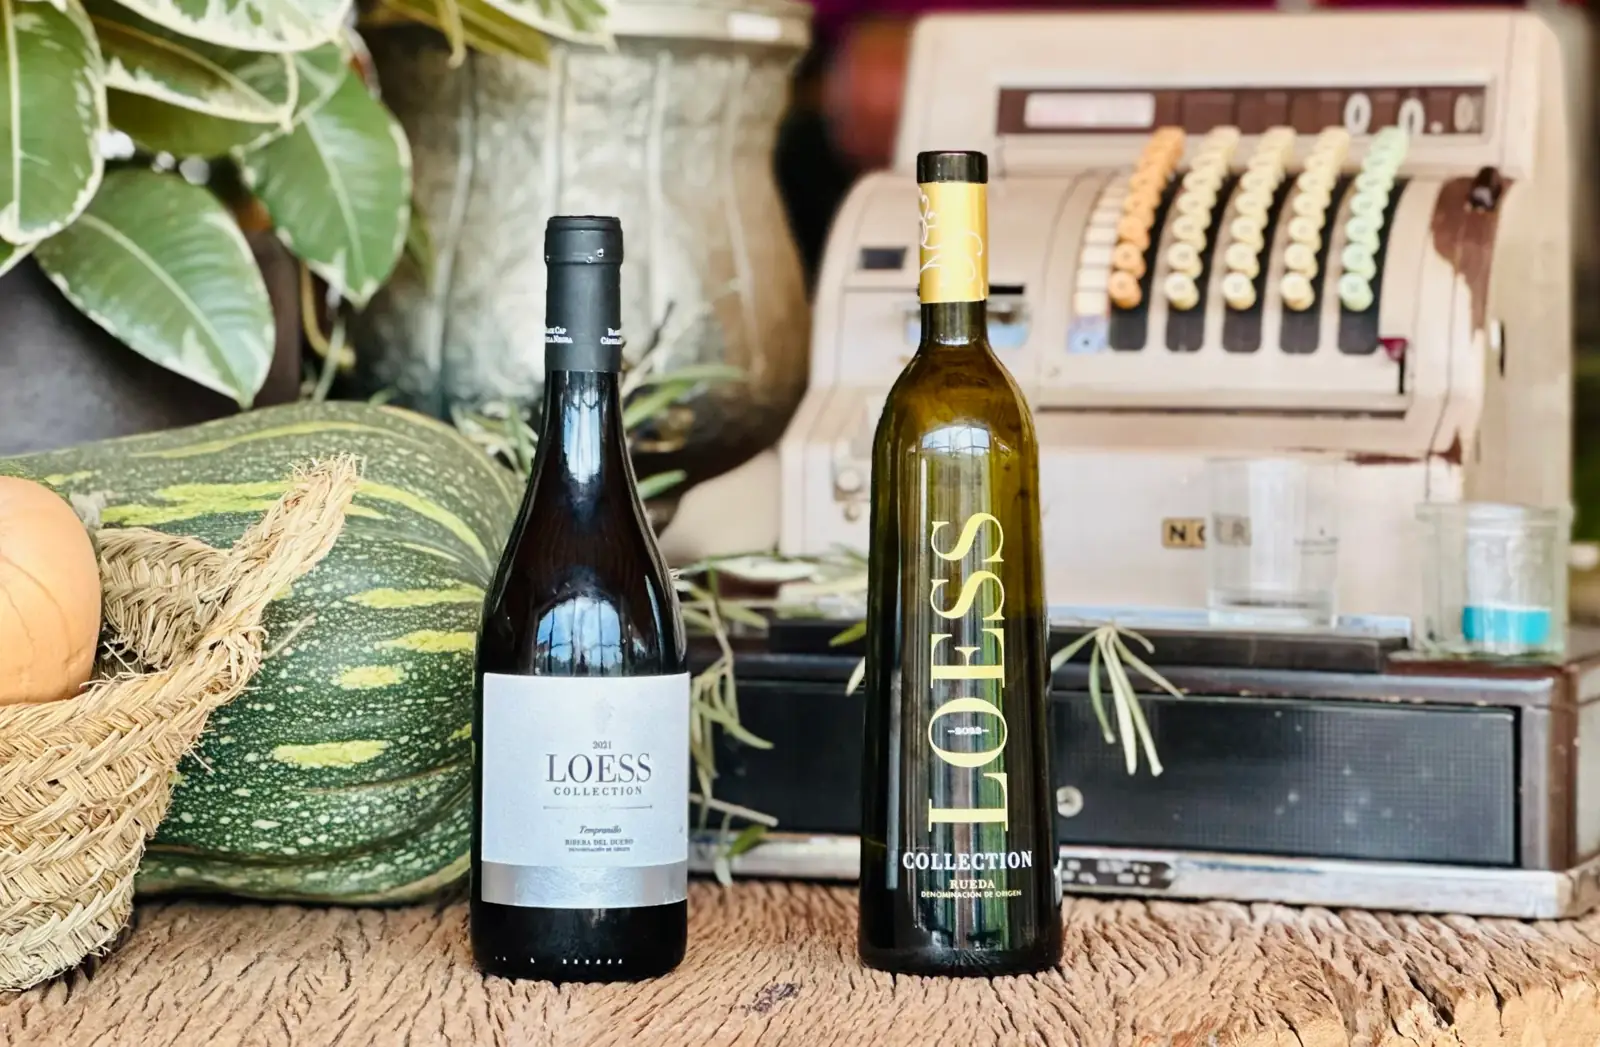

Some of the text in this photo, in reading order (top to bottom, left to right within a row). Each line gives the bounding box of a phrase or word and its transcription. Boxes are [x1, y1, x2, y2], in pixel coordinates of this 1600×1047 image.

[928, 512, 1008, 832] LOESS
[592, 740, 612, 750] 2021
[546, 753, 651, 783] LOESS
[553, 786, 642, 796] COLLECTION
[579, 824, 622, 836] Tempranillo
[902, 850, 1033, 870] COLLECTION
[949, 879, 996, 890] RUEDA
[920, 890, 982, 899] DENOMINACIÓN
[995, 890, 1022, 898] ORIGEN
